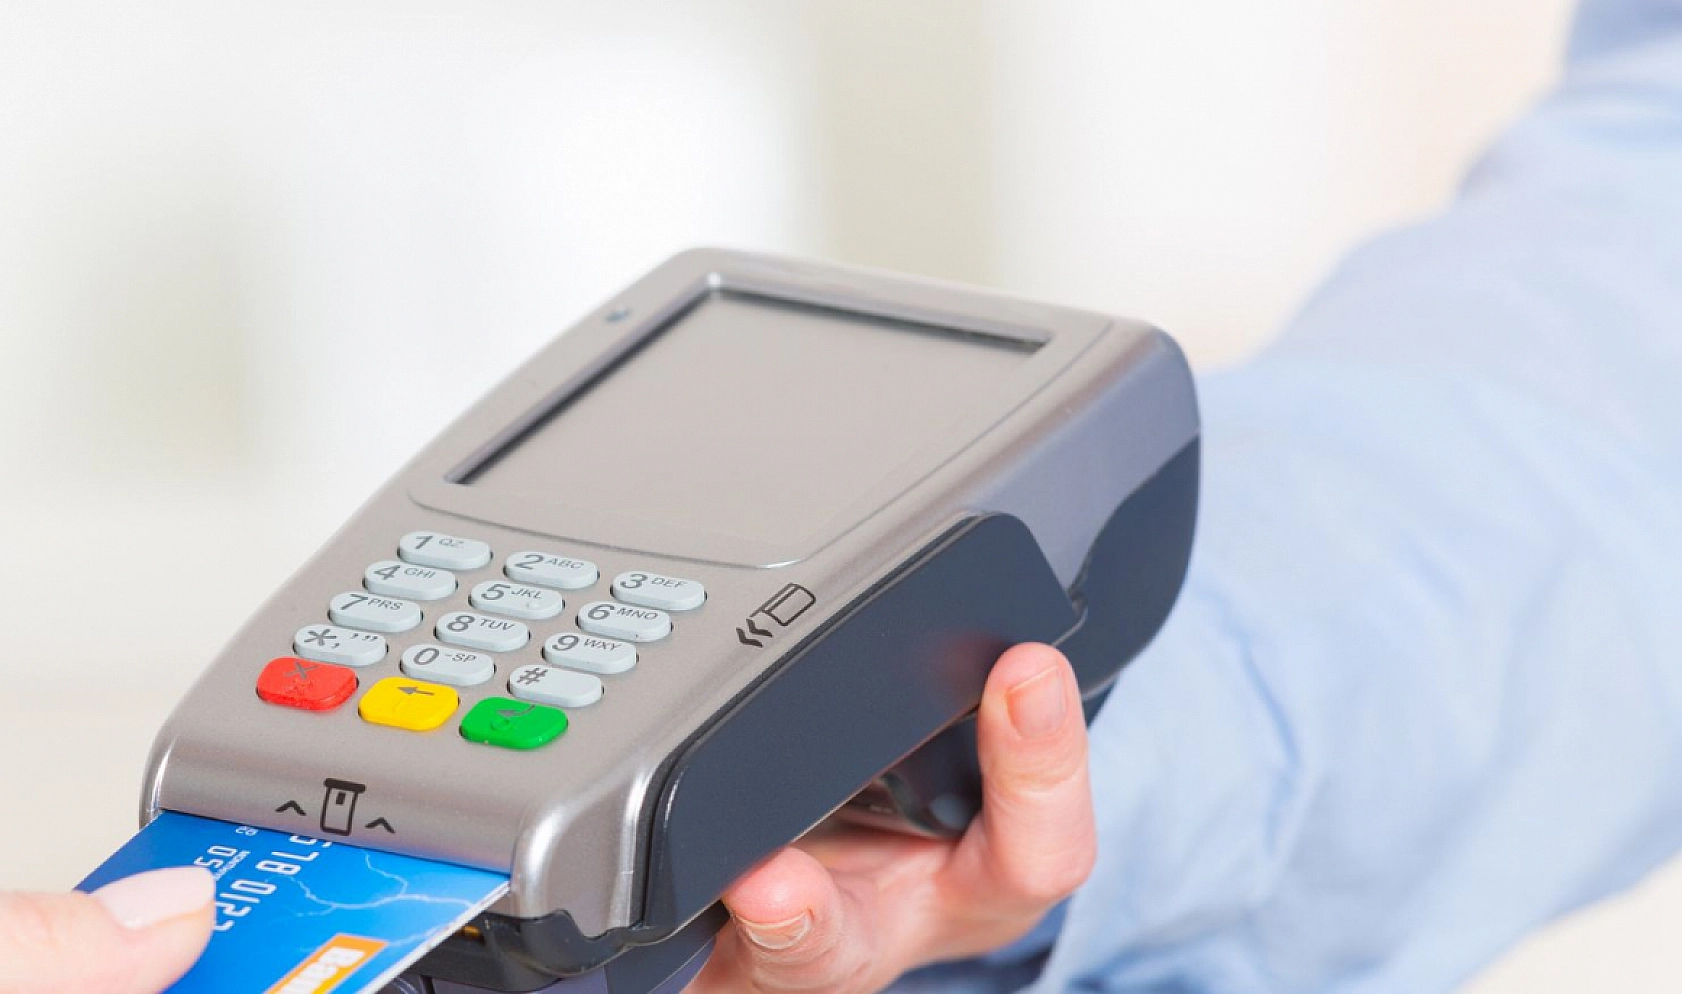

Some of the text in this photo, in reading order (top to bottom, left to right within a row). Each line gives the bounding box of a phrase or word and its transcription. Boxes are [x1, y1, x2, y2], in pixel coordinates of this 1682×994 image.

[415, 536, 433, 549] 1
[515, 555, 584, 570] 2 ABC
[374, 565, 436, 580] 4 GHI
[620, 574, 688, 588] 3 DEF
[481, 584, 542, 600] 5 JKL
[340, 594, 403, 610] 7 PRS
[588, 604, 658, 620] 6 MNO
[446, 615, 515, 632] 8 TUV
[552, 635, 621, 651] 9 WXY
[413, 648, 439, 665] 0
[516, 668, 548, 685] #
